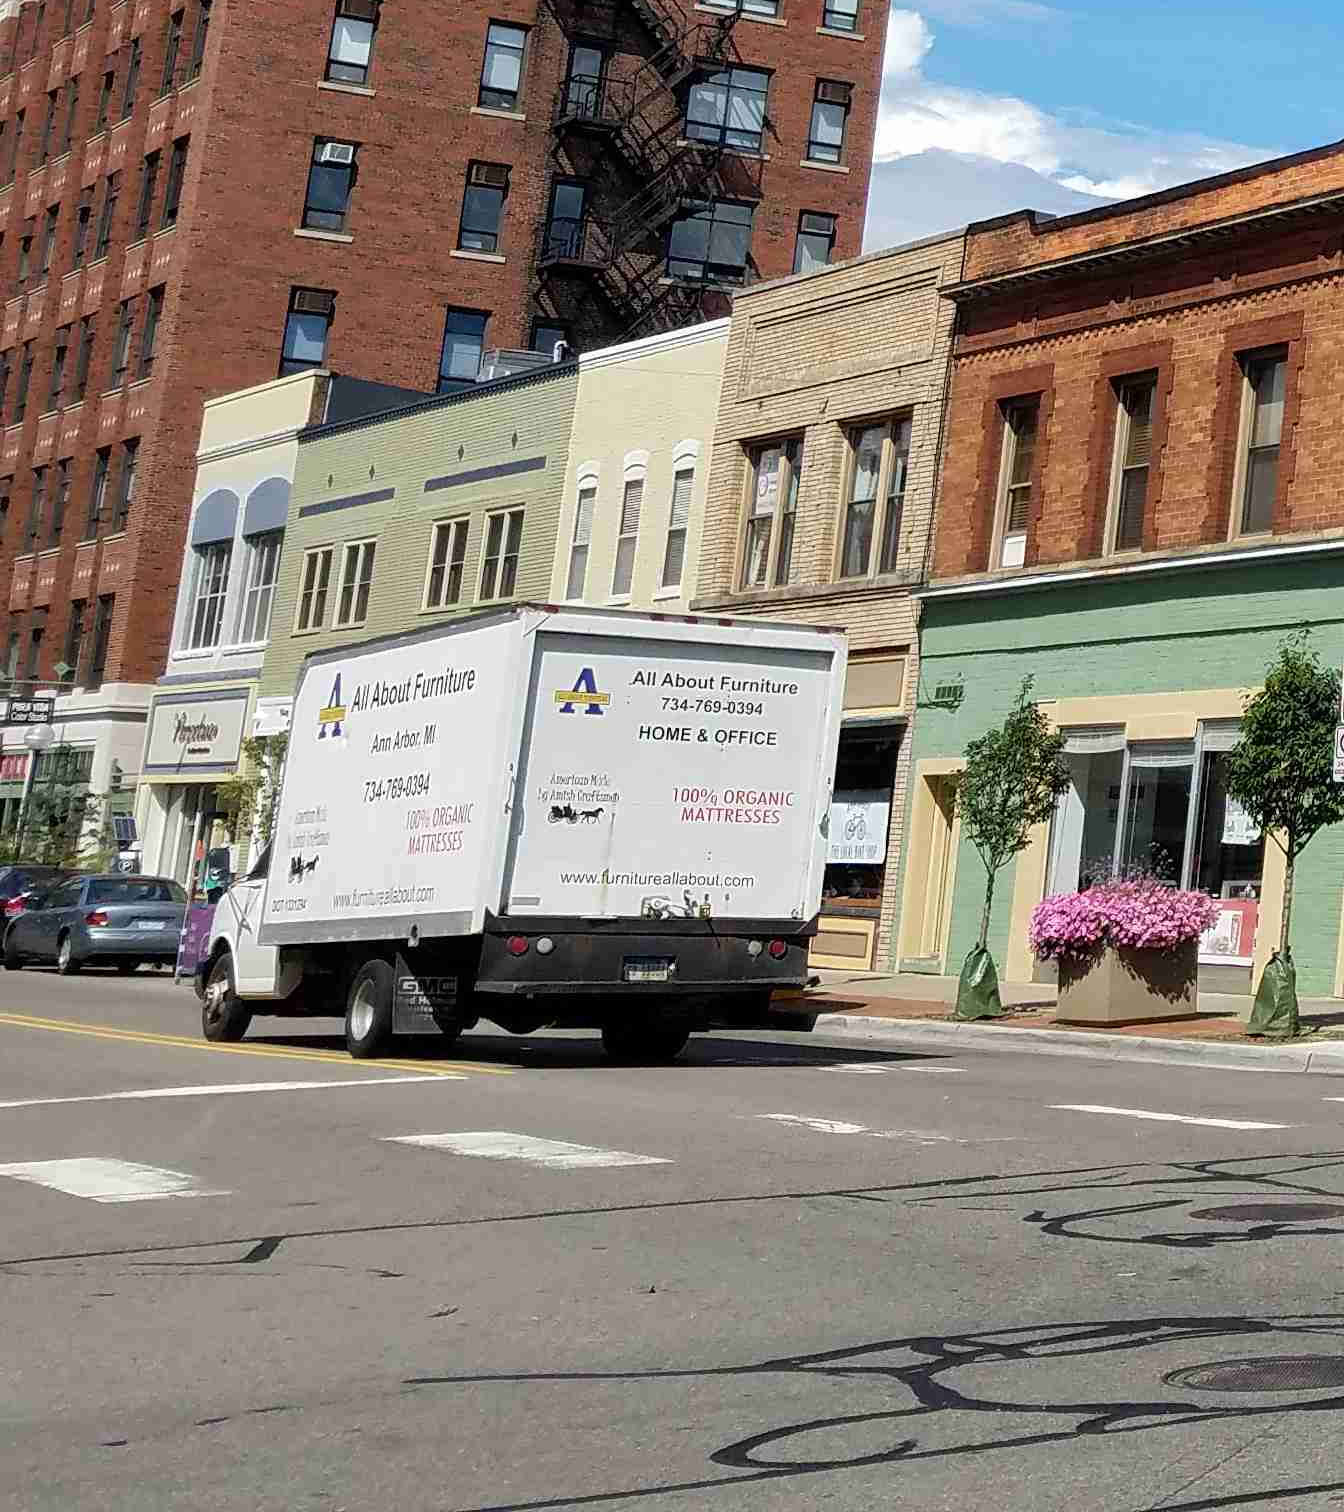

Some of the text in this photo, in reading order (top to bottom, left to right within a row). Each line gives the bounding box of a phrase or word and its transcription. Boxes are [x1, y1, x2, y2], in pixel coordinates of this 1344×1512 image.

[351, 685, 369, 712] All
[371, 676, 411, 707] About
[413, 667, 475, 700] Furniture
[632, 671, 656, 687] All
[661, 673, 715, 690] About
[720, 677, 799, 695] Furniture
[661, 697, 763, 716] 734-769-0394
[370, 736, 391, 754] Ann
[423, 724, 437, 745] MI
[639, 725, 778, 746] HOME & OFFICE
[363, 773, 431, 802] 734-769-0394
[549, 789, 576, 801] Amish
[672, 787, 795, 807] 100% ORGANIC
[406, 803, 475, 830] 100% ORGANIC
[681, 807, 781, 825] MATTRESSES
[408, 831, 464, 855] MATTRESSES
[560, 870, 755, 888] www.furnitureallabout.com
[332, 886, 435, 908] www.furnitureallabout.com
[402, 980, 456, 994] GMC
